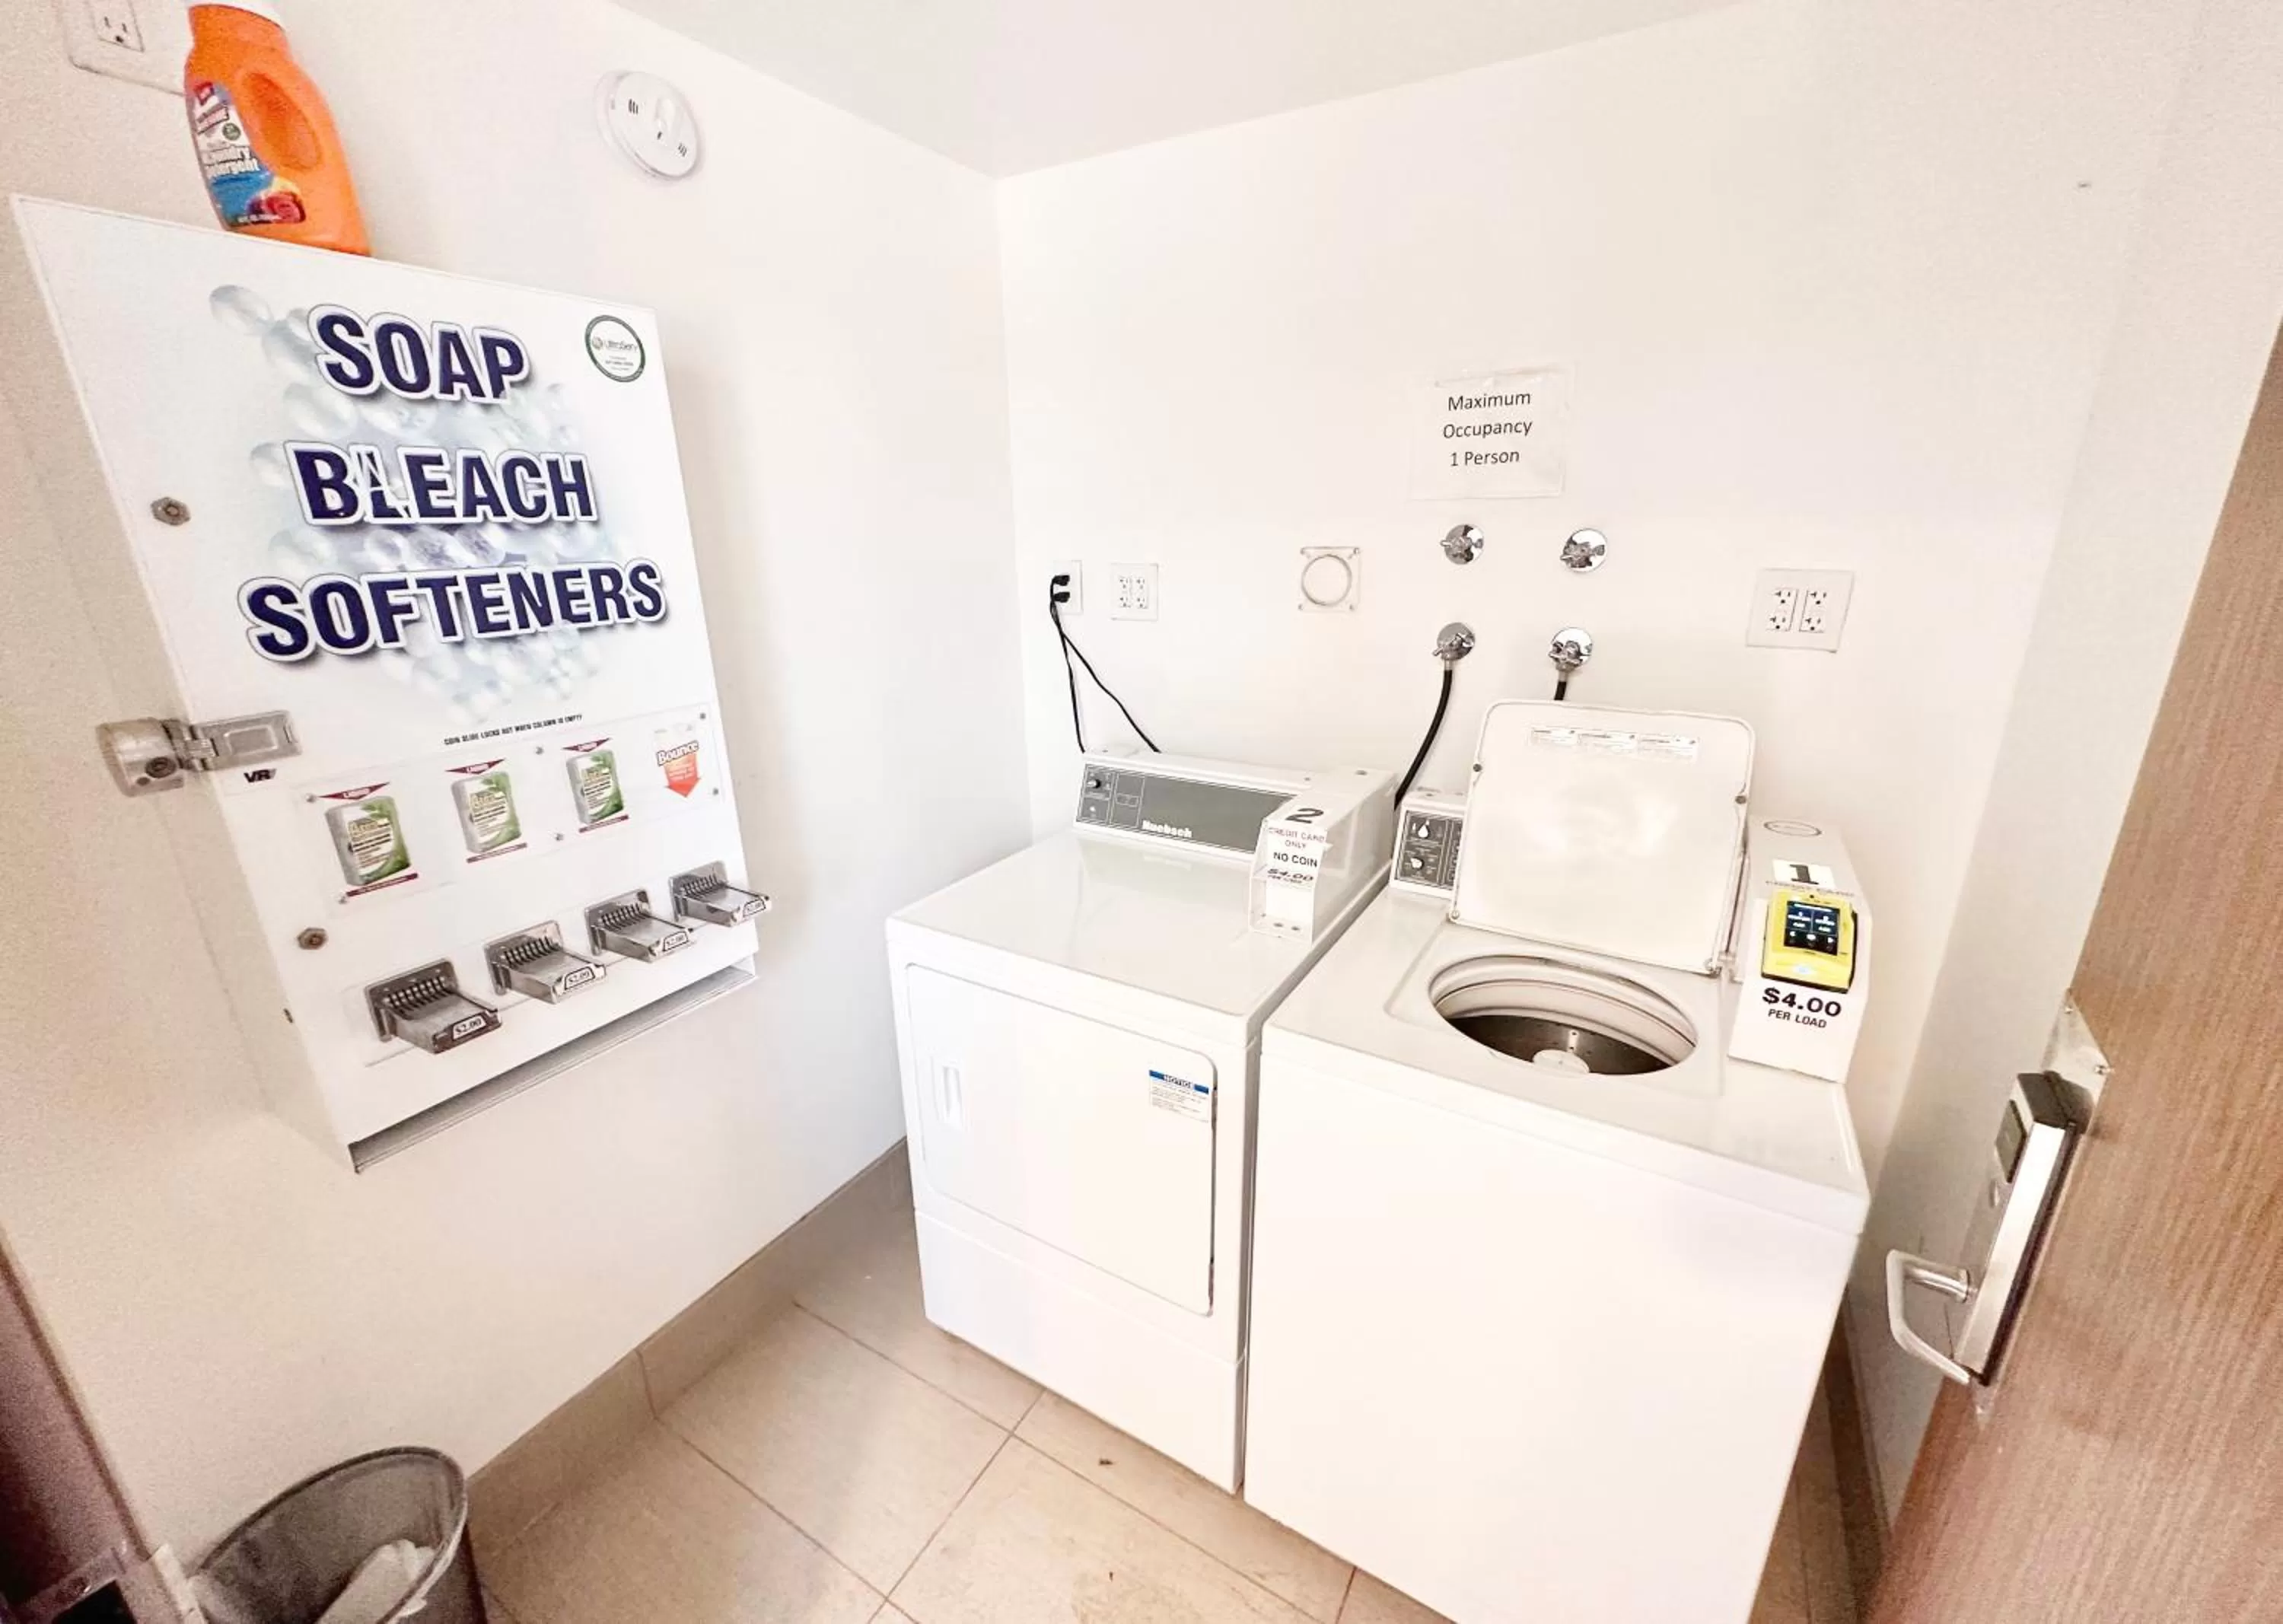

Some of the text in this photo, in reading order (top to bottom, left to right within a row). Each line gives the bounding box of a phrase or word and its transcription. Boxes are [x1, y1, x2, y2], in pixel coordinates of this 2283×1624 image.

[311, 307, 527, 401] SOAP
[1447, 392, 1531, 411] Maximum
[1443, 420, 1533, 439] Occupancy
[1450, 451, 1520, 466] 1 Person
[289, 445, 595, 521] BLEACH
[243, 561, 664, 659] SOFTENERS
[657, 741, 699, 766] Bounce
[1285, 807, 1324, 824] 2
[1269, 826, 1325, 842] CREDIT CARD
[1284, 839, 1307, 849] ONLY
[1273, 852, 1318, 868] NO COIN
[1788, 864, 1820, 885] 1
[1762, 986, 1842, 1017] $4.00
[455, 1017, 482, 1035] $2.00
[1768, 1009, 1827, 1028] PER LOAD
